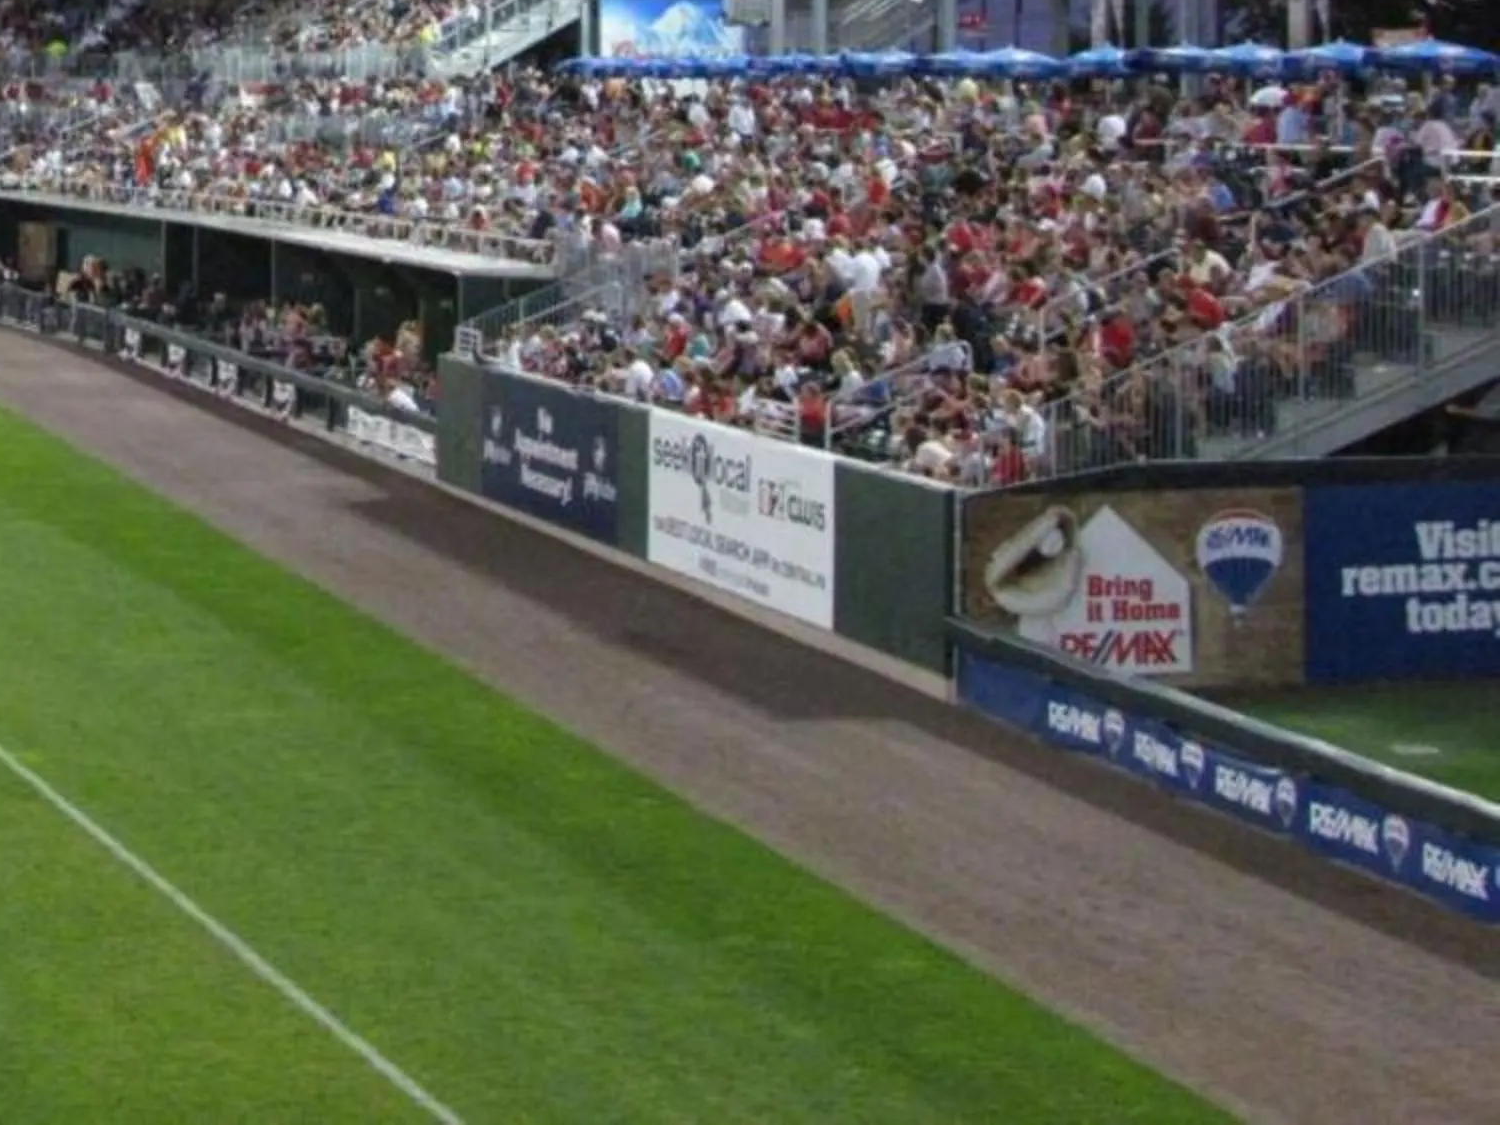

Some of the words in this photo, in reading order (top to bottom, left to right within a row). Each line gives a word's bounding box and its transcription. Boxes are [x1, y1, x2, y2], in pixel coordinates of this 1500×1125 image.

[1087, 574, 1152, 601] Bring
[1087, 601, 1102, 622] it
[1113, 601, 1181, 621] Home
[1309, 801, 1380, 855] RE/MAX
[1422, 841, 1490, 902] RE/MAX
